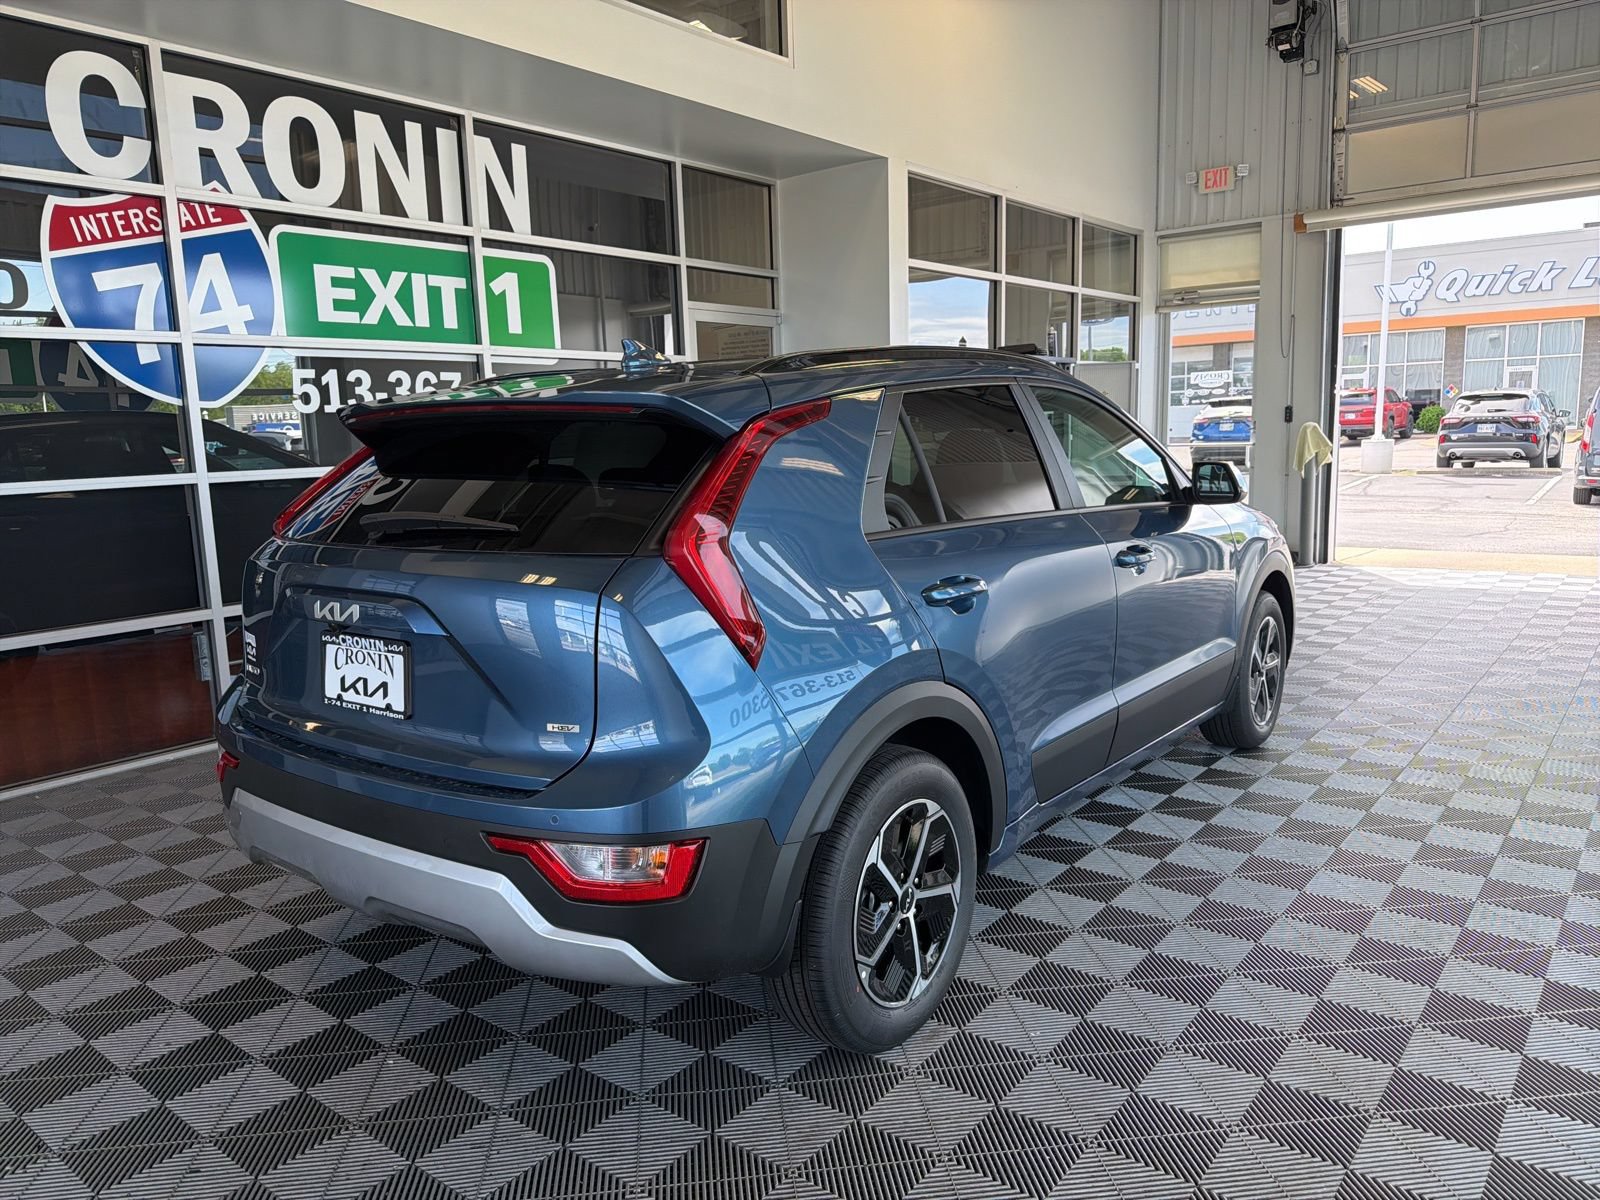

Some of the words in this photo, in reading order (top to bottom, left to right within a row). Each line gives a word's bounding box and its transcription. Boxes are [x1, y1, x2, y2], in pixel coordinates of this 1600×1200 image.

[45, 50, 532, 235] CRONIN
[1204, 167, 1230, 190] EXIT
[70, 202, 222, 243] INTERSATE
[1435, 260, 1567, 303] Quick
[92, 253, 255, 366] 74
[313, 264, 467, 331] EXIT
[489, 271, 523, 335] 1
[314, 600, 360, 623] KIA
[339, 634, 385, 652] CRONIN
[334, 647, 395, 680] CRONIN
[340, 674, 389, 701] KIA
[324, 698, 341, 707] I-74
[343, 700, 360, 711] EXIT
[370, 707, 404, 720] Harrison
